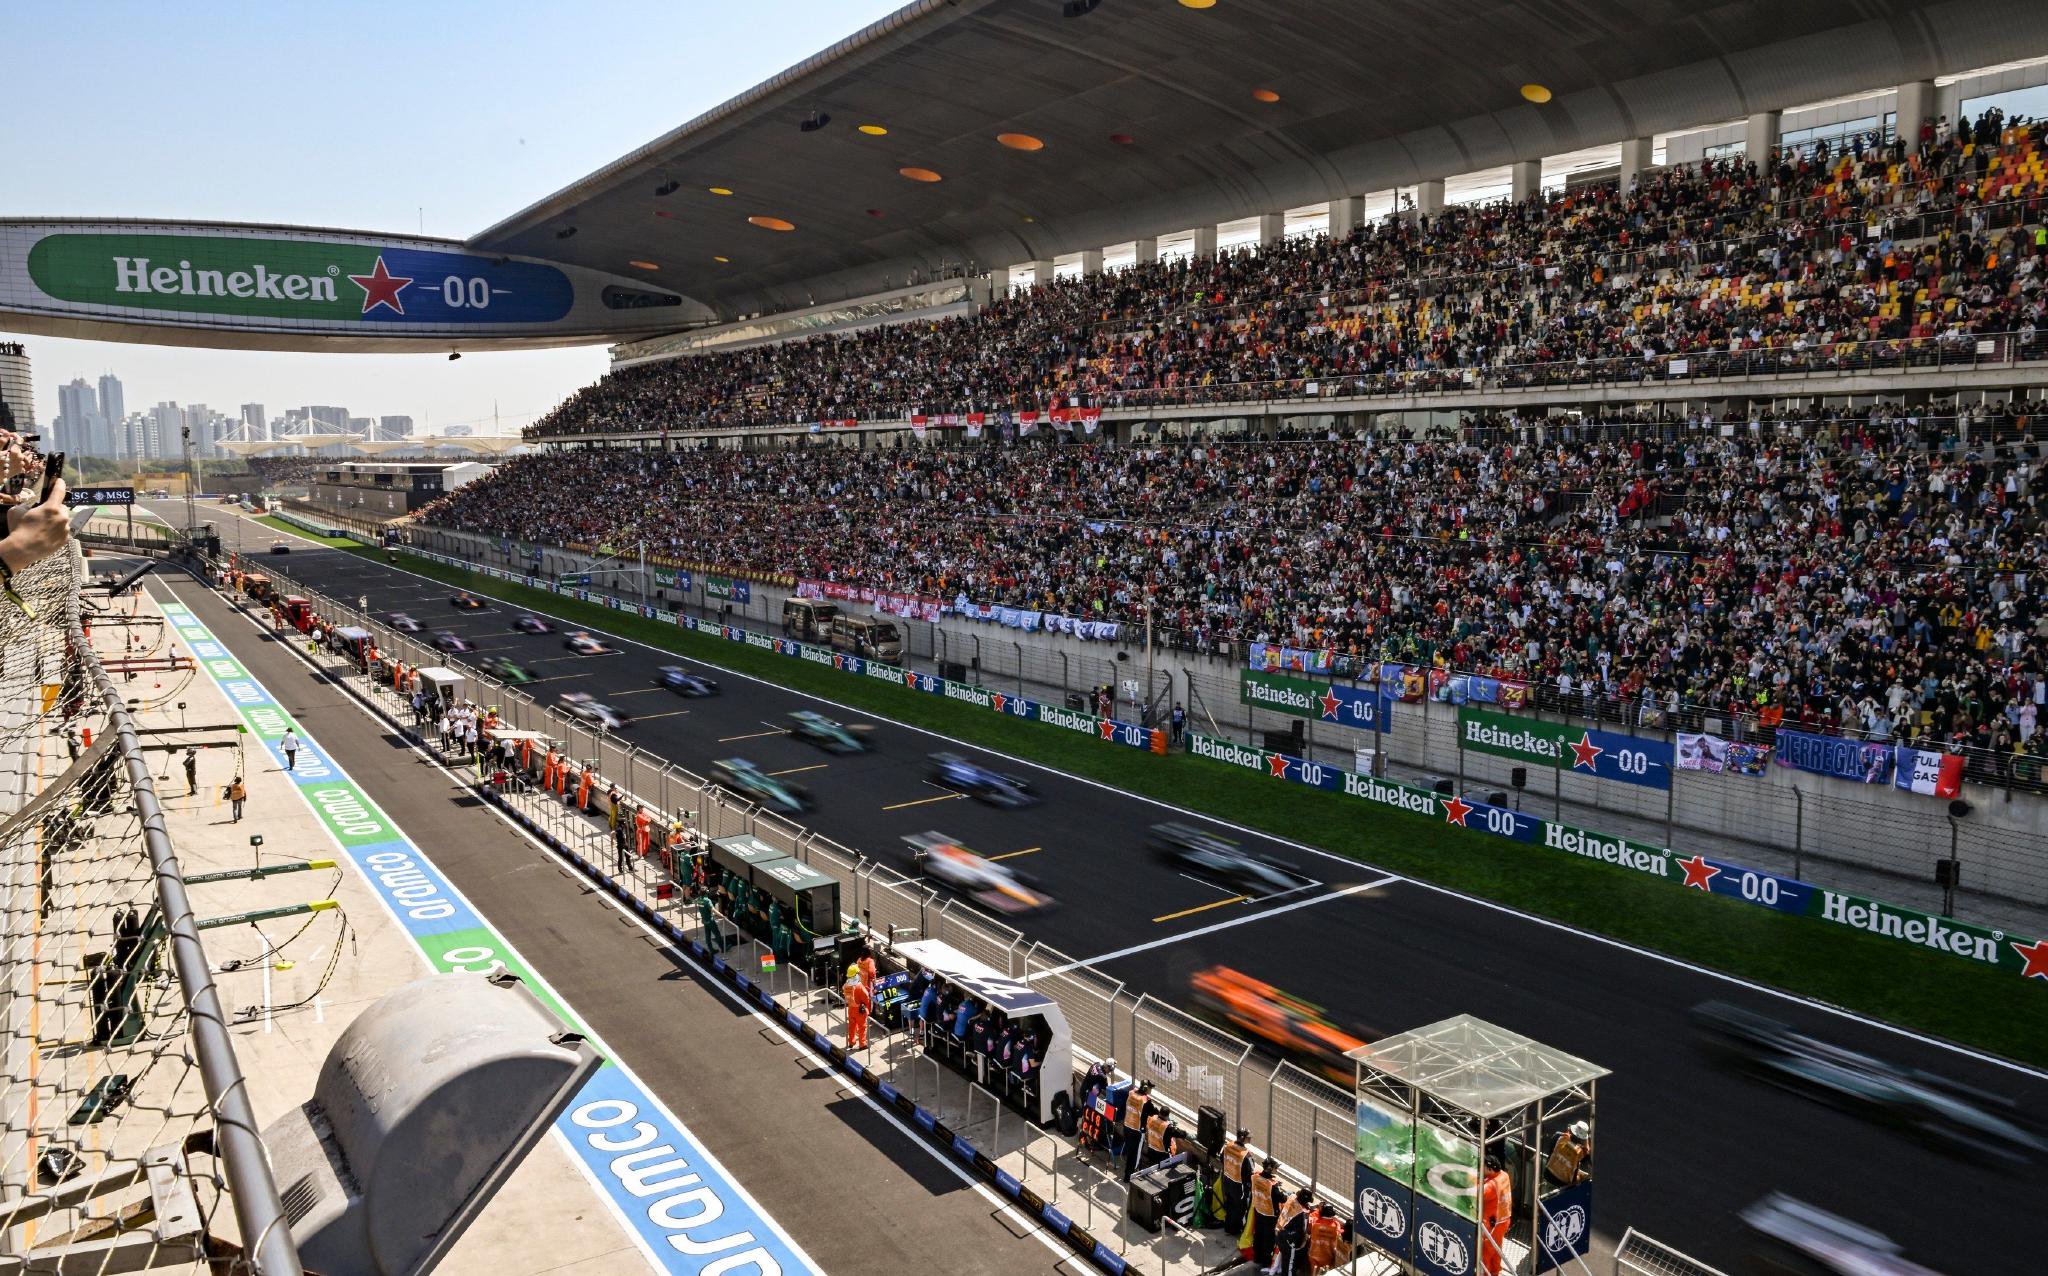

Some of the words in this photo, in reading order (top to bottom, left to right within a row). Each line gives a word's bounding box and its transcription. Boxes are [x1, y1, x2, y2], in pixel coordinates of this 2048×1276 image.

[112, 256, 338, 302] Heineken
[443, 275, 490, 309] 0.0
[106, 491, 130, 499] MSC
[745, 630, 773, 651] Heineken
[800, 645, 832, 666] Heineken
[866, 661, 904, 685] Heineken
[923, 676, 934, 692] 0.0
[1506, 687, 1525, 702] 24
[944, 680, 989, 707] Heineken
[1013, 698, 1026, 717] 0.0
[1246, 680, 1315, 710] Heineken
[1353, 700, 1373, 721] 0.0
[1040, 704, 1095, 735] Heineken
[1125, 727, 1141, 746] 0.0
[1191, 734, 1263, 771] Heineken
[1301, 762, 1322, 786] 0.0
[1466, 720, 1563, 758] Heineken
[1618, 749, 1648, 775] 0.0
[1911, 755, 1945, 769] FULL
[1912, 770, 1939, 784] GAS
[313, 789, 383, 836] aramco
[1344, 772, 1435, 816] Heineken
[1487, 808, 1515, 836] 0.0
[1544, 822, 1668, 877] Heineken
[1741, 871, 1779, 906] 0.0
[366, 851, 456, 920] aramco
[218, 915, 246, 924] aramco
[1821, 890, 2000, 964] Heineken
[570, 1099, 783, 1276] aramco
